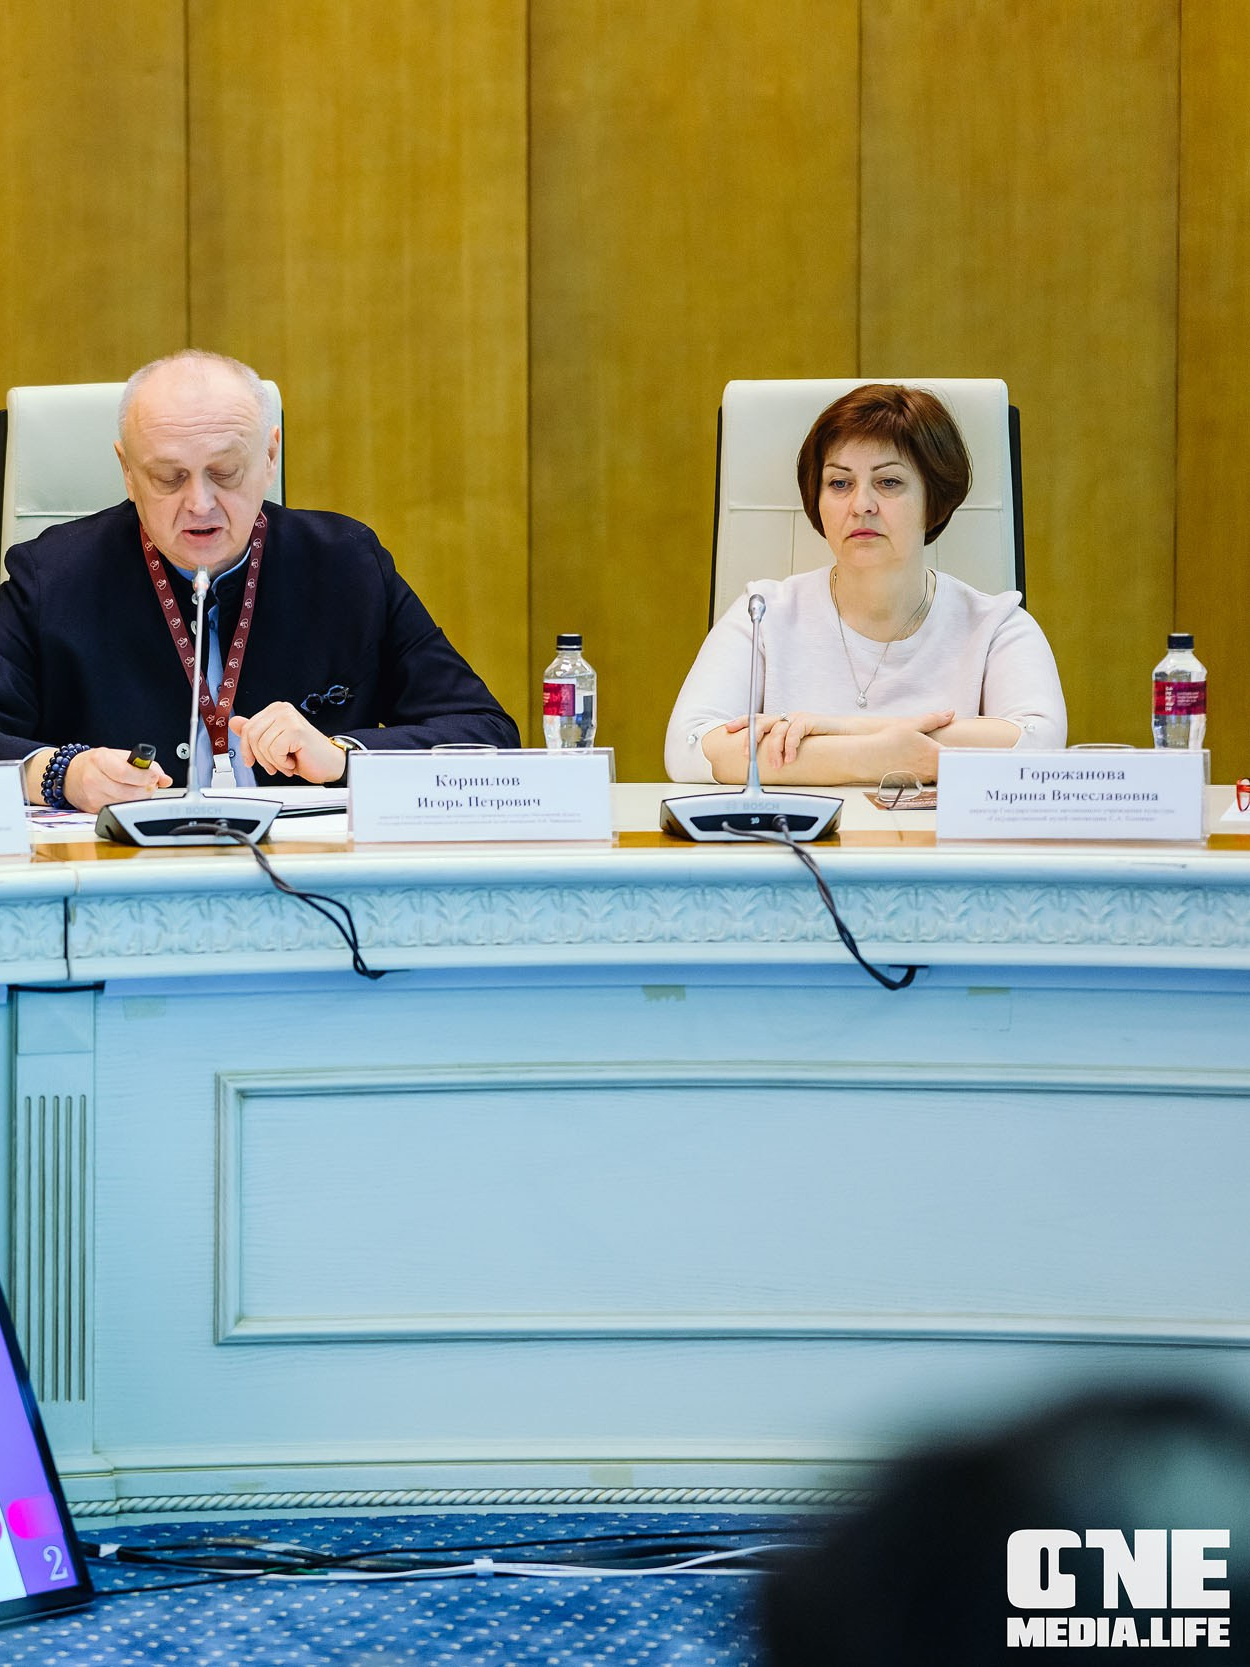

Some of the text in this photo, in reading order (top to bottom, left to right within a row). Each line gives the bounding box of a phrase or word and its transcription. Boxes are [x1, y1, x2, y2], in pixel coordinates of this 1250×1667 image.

[435, 774, 521, 791] Корнилов
[1019, 767, 1126, 784] Горожанова
[416, 796, 541, 811] Игорь Петрович
[985, 789, 1159, 804] Марина Вячеславовна
[743, 801, 780, 810] BOSCH
[42, 1543, 69, 1582] 2
